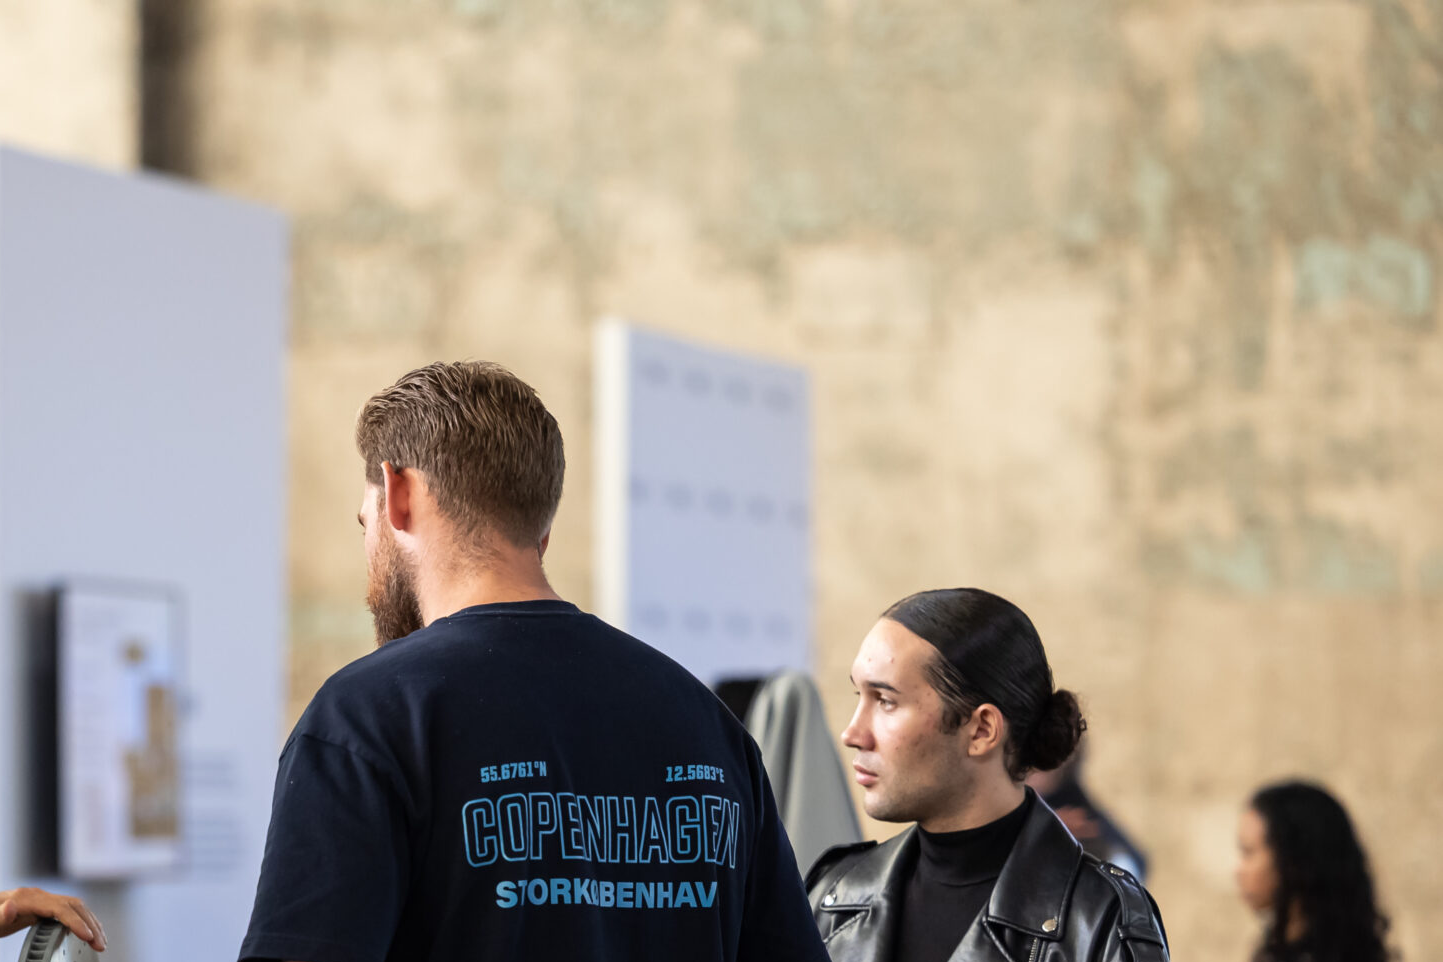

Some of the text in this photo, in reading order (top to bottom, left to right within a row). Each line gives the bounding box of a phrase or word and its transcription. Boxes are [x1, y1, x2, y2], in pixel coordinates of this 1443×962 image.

[480, 760, 725, 783] 55.6761°N 12.5683°E
[461, 792, 740, 869] COPENHAGEN
